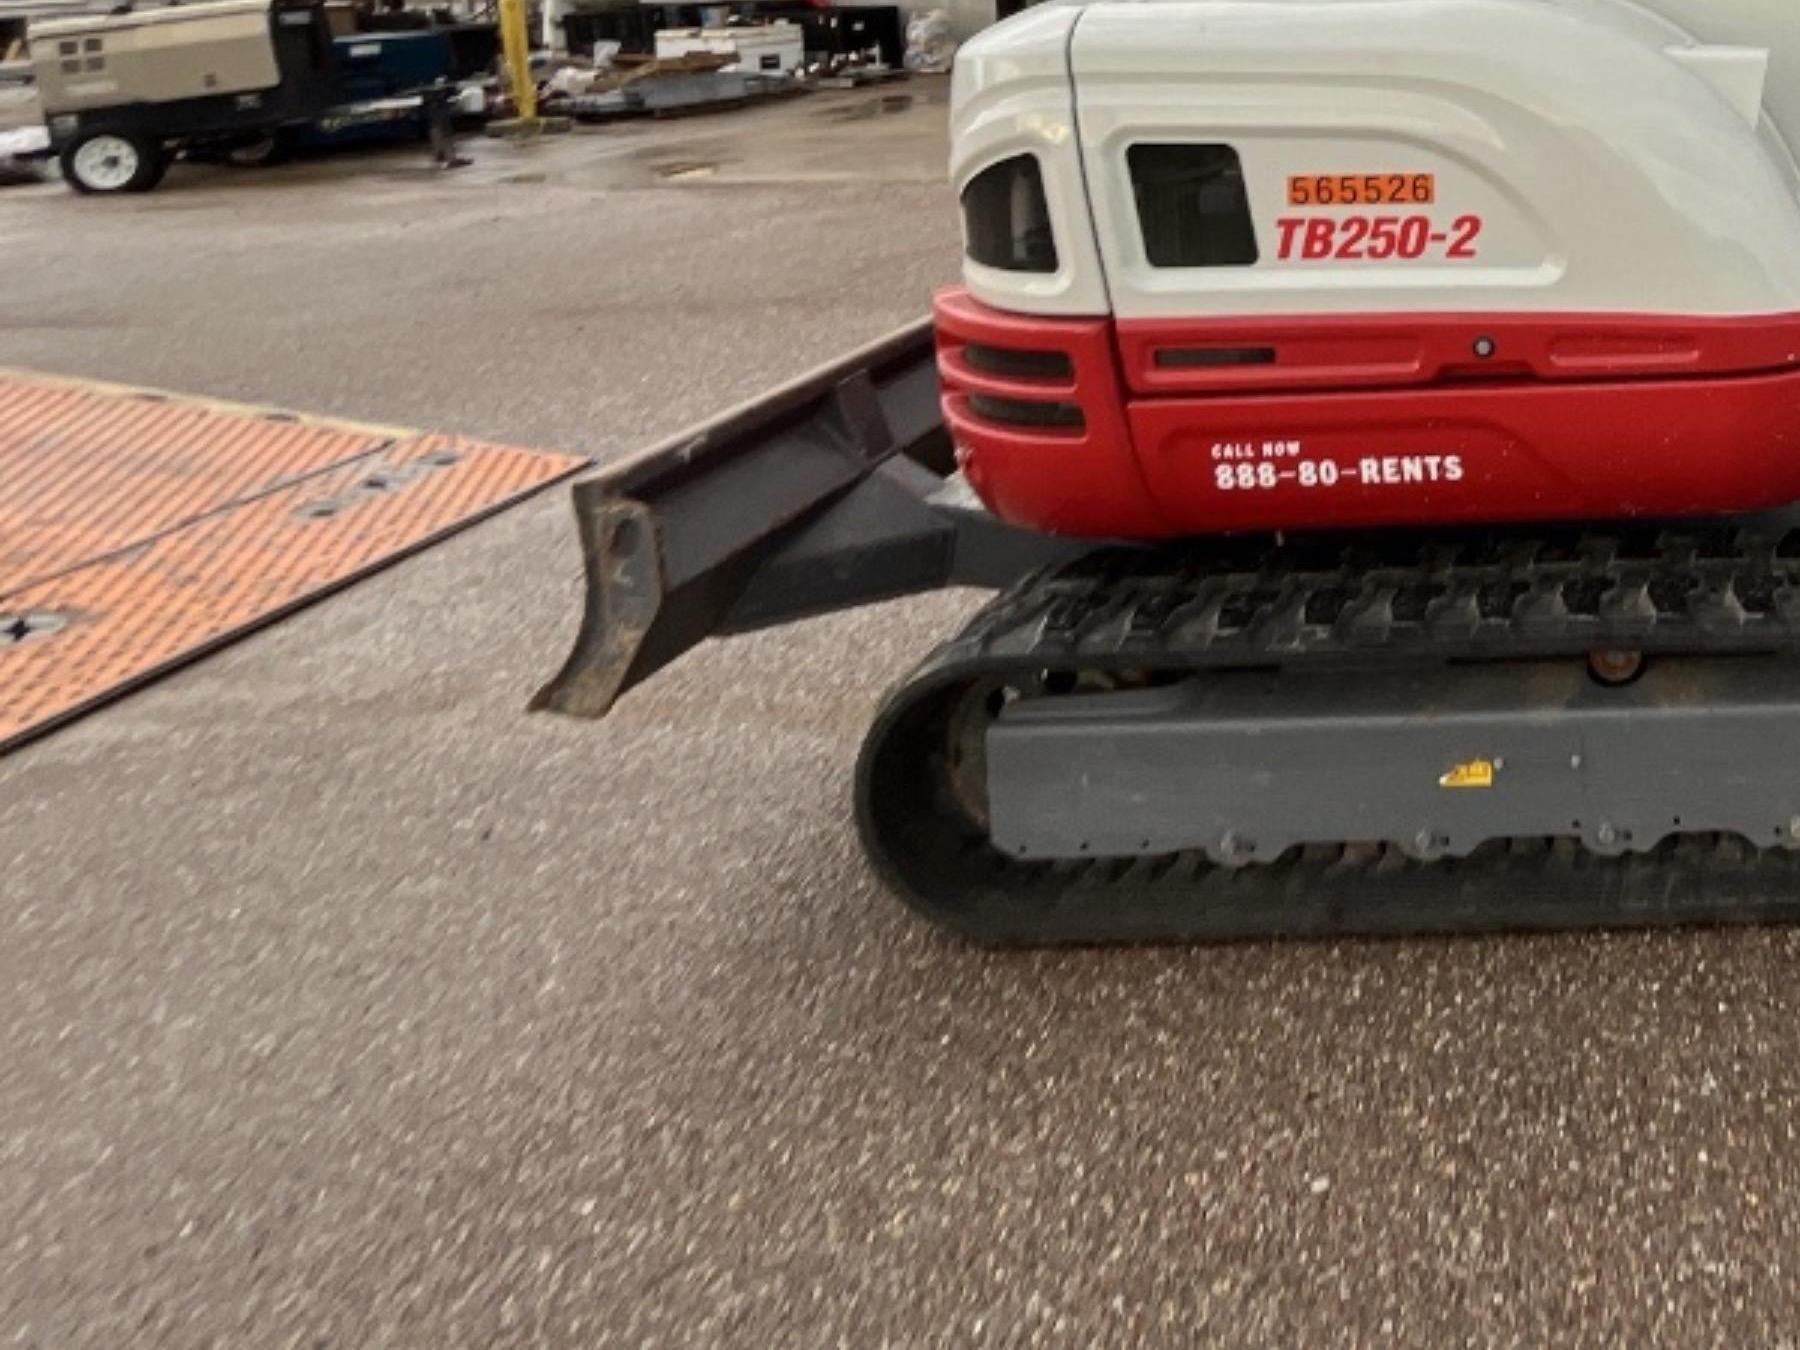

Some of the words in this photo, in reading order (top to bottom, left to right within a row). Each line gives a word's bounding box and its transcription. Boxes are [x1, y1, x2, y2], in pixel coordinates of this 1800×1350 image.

[1290, 174, 1430, 205] 565526
[1275, 214, 1483, 260] TB250-2
[1210, 443, 1255, 459] CALL
[1262, 441, 1300, 457] NOW
[1214, 454, 1464, 491] 888-80-RENTS
